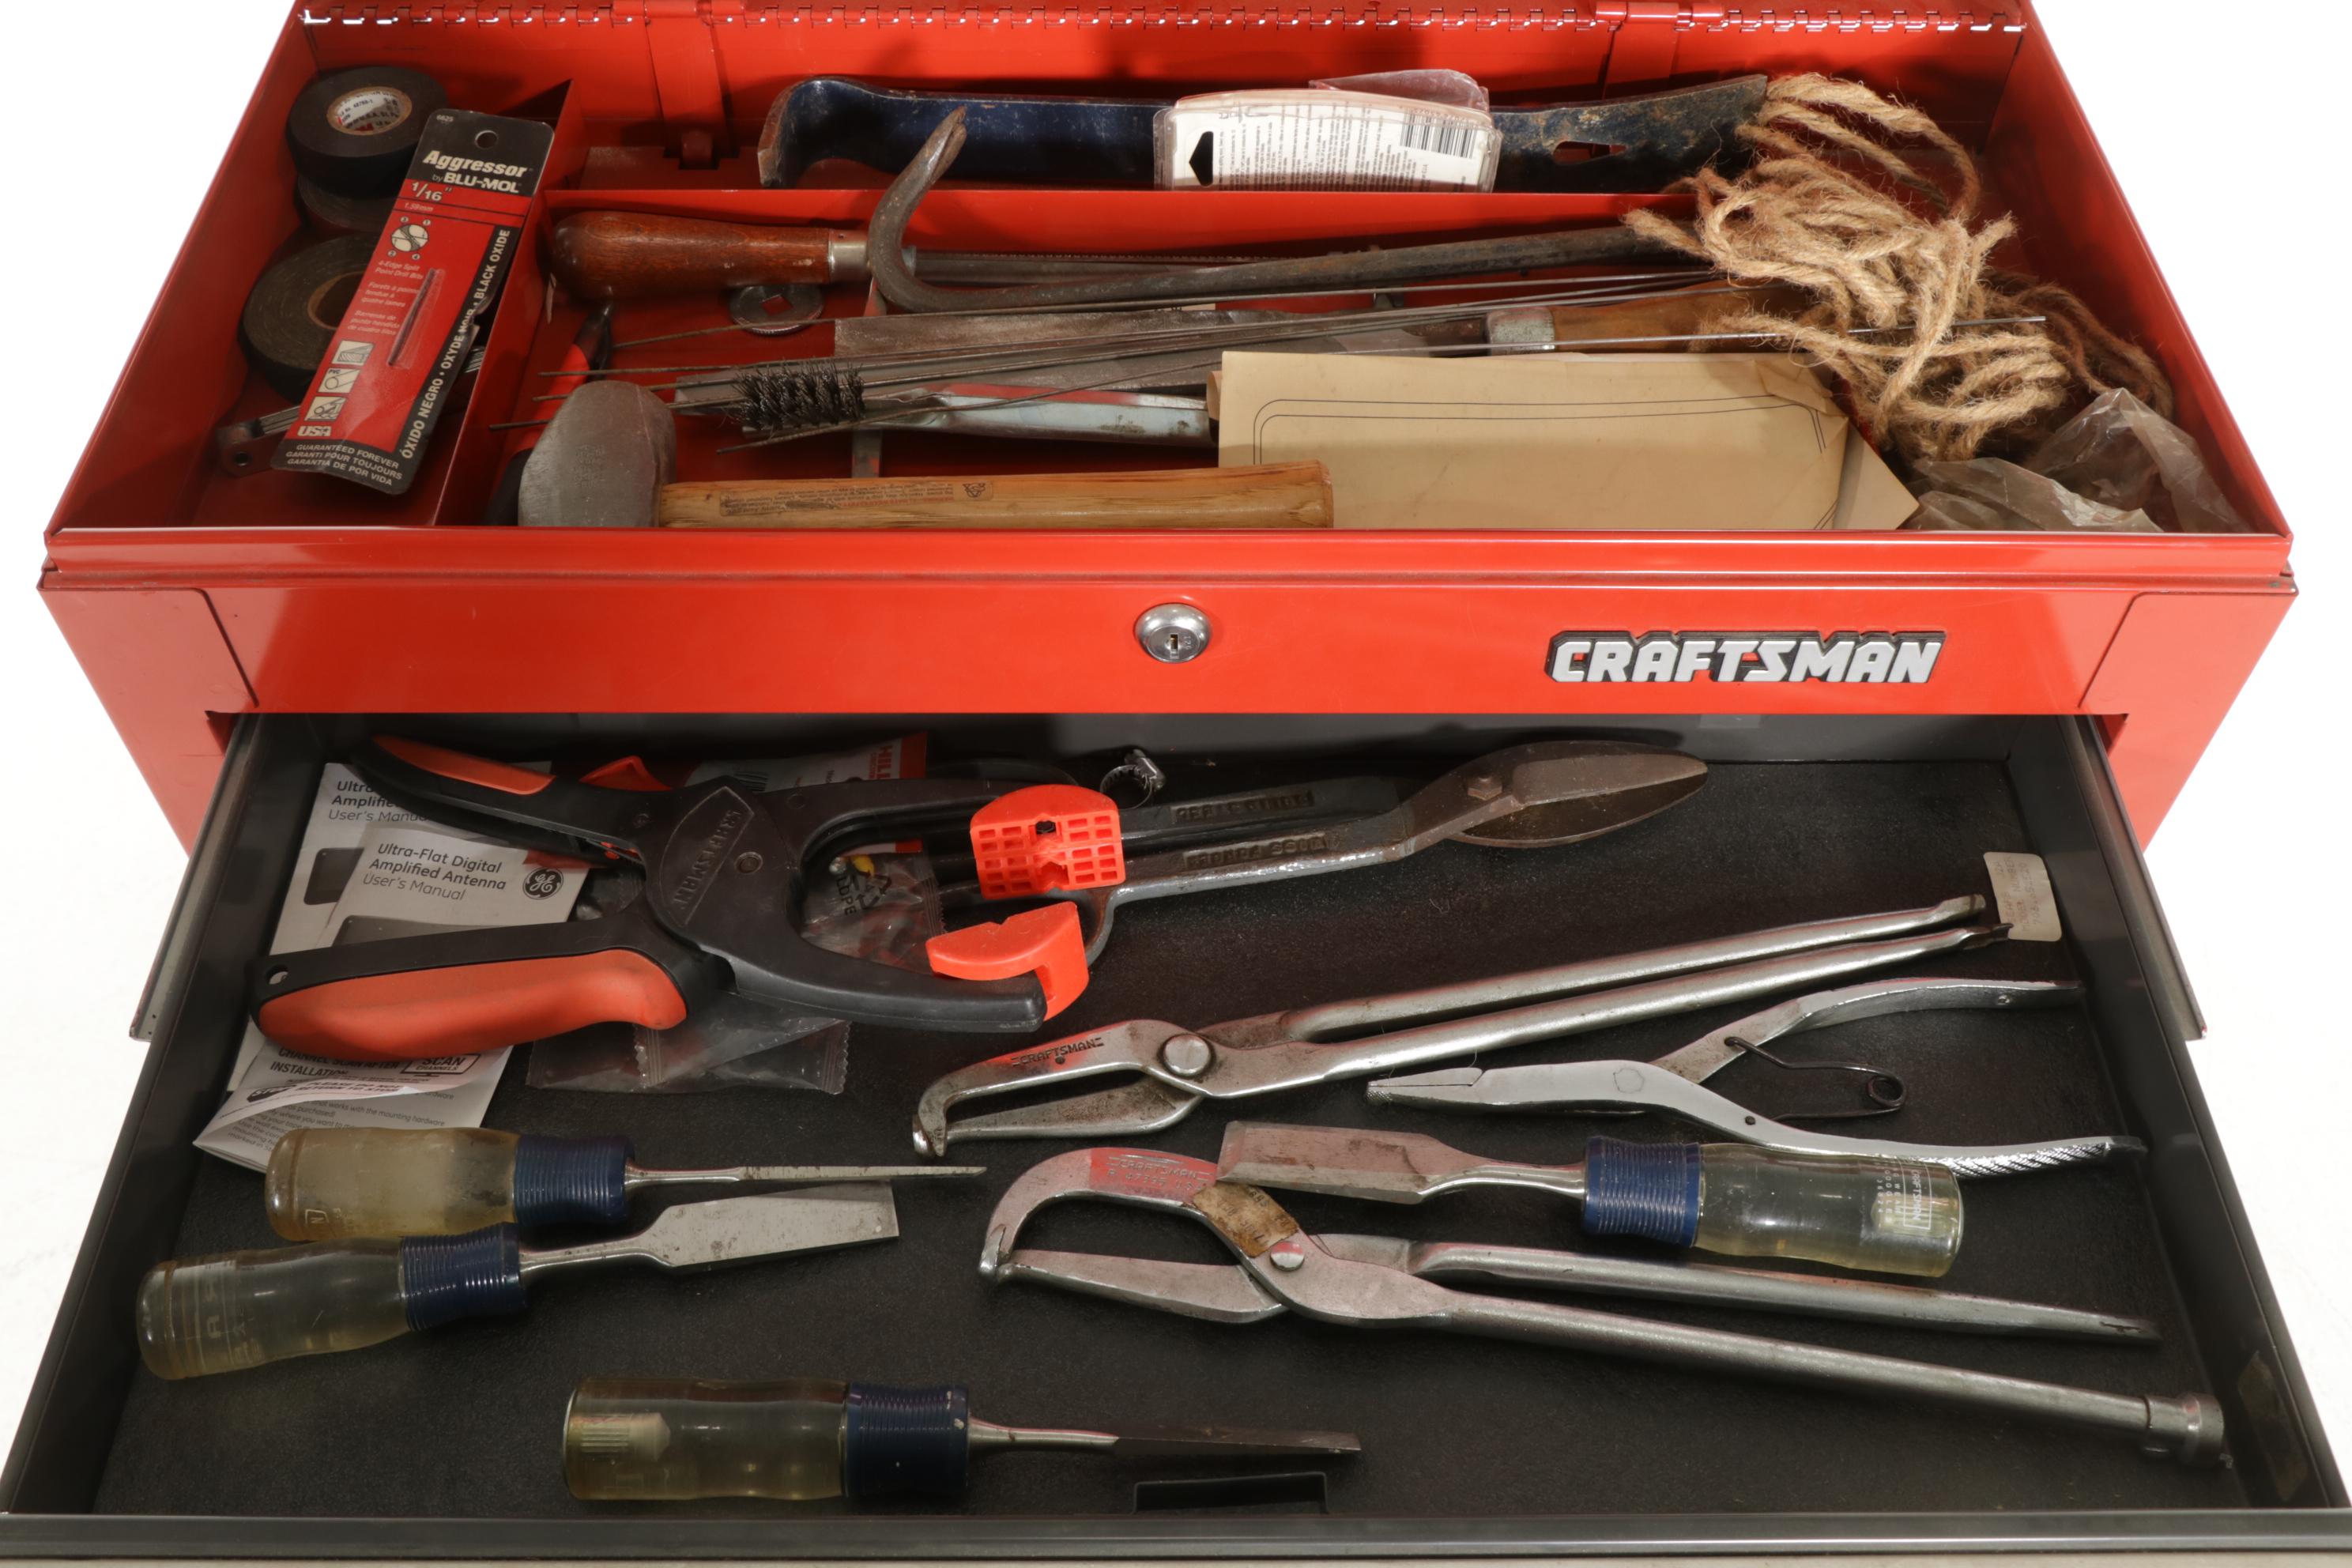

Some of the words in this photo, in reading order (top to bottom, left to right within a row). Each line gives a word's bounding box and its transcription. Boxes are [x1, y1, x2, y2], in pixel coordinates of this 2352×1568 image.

[422, 150, 529, 178] Aggressor
[432, 173, 443, 183] by
[443, 172, 520, 194] BLU-MOL
[474, 264, 497, 300] BLACK
[488, 228, 511, 262] OXIDE
[440, 335, 465, 370] OXYDE
[297, 425, 332, 437] USA
[398, 419, 425, 460] ÓXIDO
[417, 377, 444, 419] NEGRO
[296, 444, 356, 455] GUARANTEED
[356, 449, 400, 469] FOREVER
[325, 451, 351, 462] POUR
[352, 457, 403, 481] TOUJOURS
[333, 461, 347, 470] DE
[348, 465, 369, 477] POR
[371, 472, 393, 486] VIDA
[1548, 635, 1944, 684] CRAFTSMAN
[328, 809, 374, 822] User's
[378, 842, 449, 865] Ultra-Flat
[451, 854, 503, 873] Digital
[363, 873, 406, 889] User's
[409, 879, 466, 901] Manual
[369, 858, 439, 880] Amplified
[442, 870, 507, 890] Antenna
[1019, 1038, 1097, 1065] CRAFTSMAN
[1120, 1159, 1197, 1179] CRAFTSMAN
[1910, 1169, 1922, 1221] CRAFTSMAN
